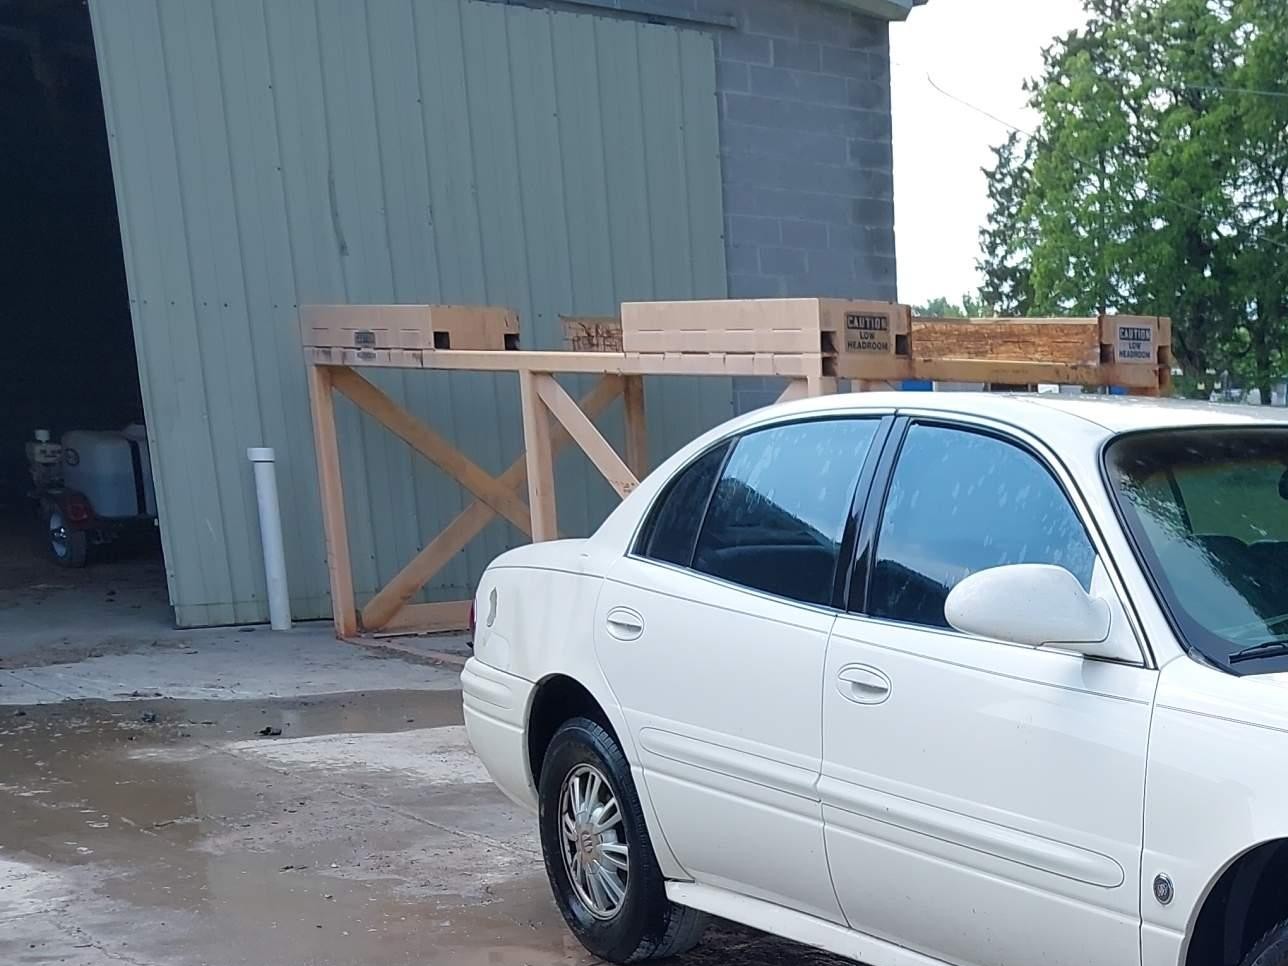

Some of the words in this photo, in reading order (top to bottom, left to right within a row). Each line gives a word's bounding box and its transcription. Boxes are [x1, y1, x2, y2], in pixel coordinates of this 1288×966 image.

[847, 315, 887, 329] CAUTION
[859, 332, 875, 340] LOW
[1119, 327, 1151, 340] CAUTION
[847, 341, 888, 351] HEADROOM
[1129, 342, 1142, 350] LOW
[1119, 350, 1151, 359] HEADROOM
